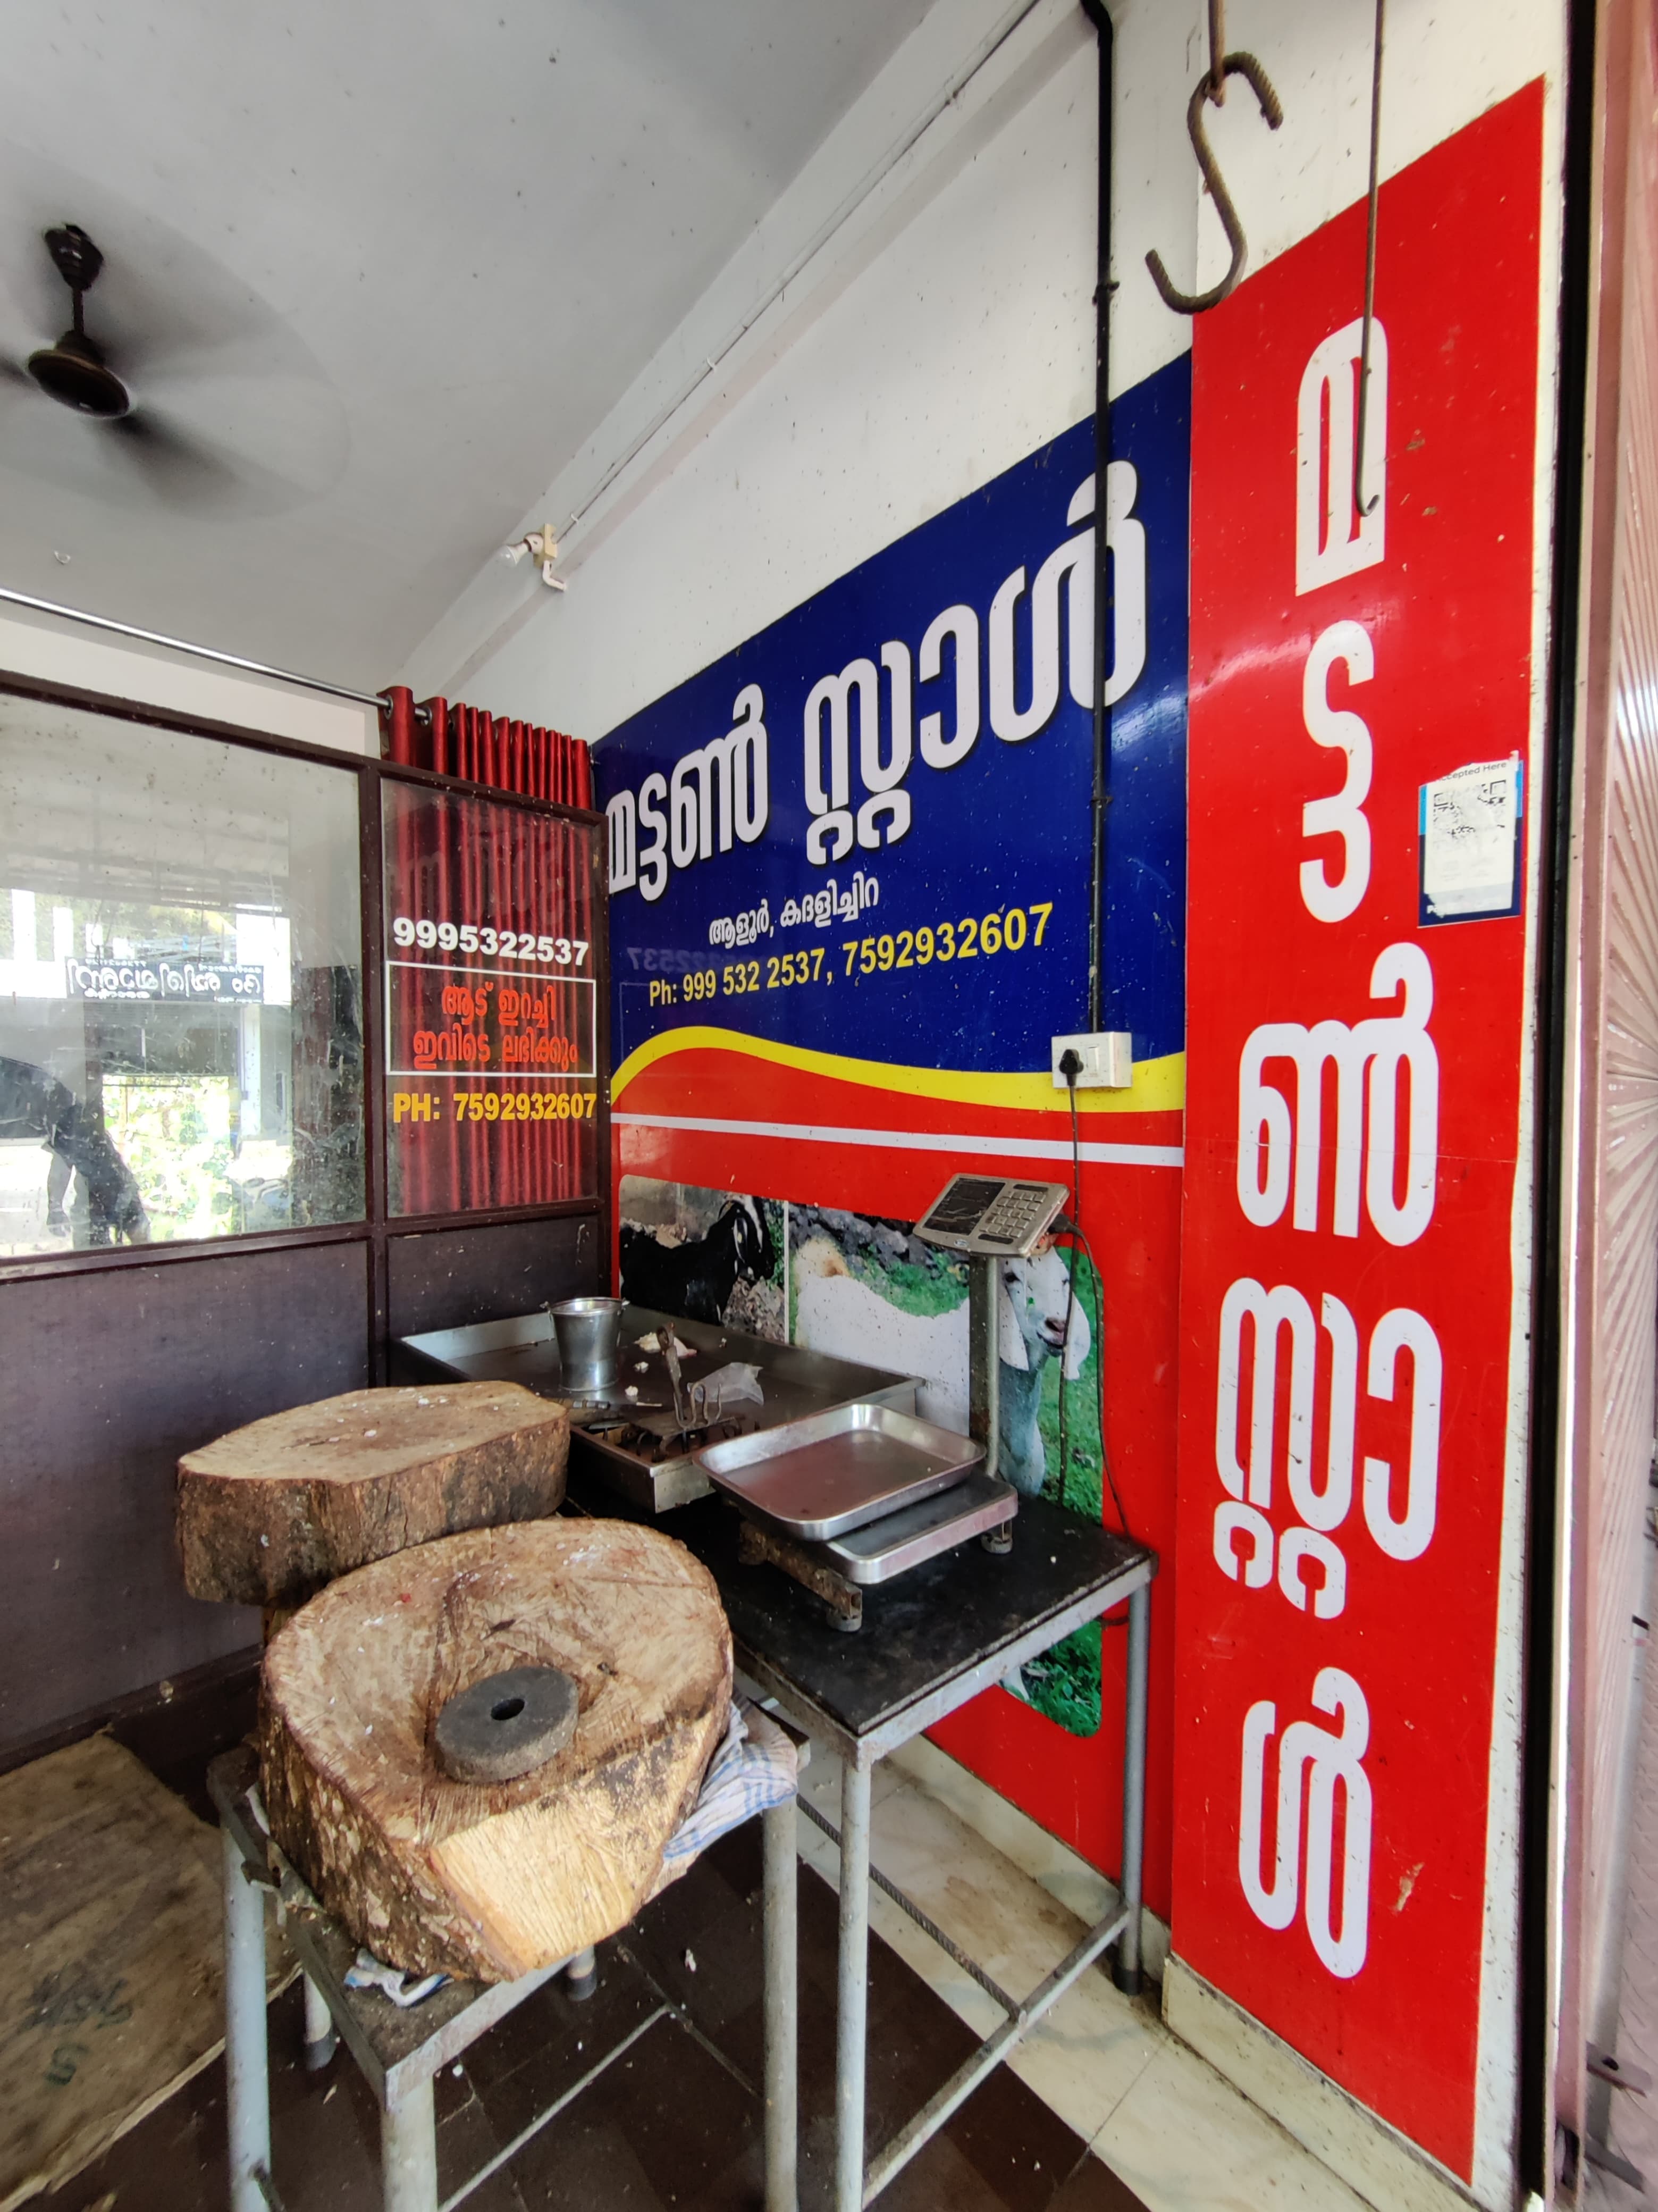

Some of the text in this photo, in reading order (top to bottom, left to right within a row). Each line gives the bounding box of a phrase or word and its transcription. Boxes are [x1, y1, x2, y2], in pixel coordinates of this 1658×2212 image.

[605, 683, 768, 901] മട്ടൺ
[1438, 761, 1507, 782] ccepted Here
[780, 871, 879, 928] കദളിച്ചിറ
[393, 917, 589, 966] 9995322537
[650, 979, 677, 1007] Ph:
[683, 969, 716, 1002] 999
[722, 961, 760, 995] 532
[842, 902, 1054, 977] 7592932607
[442, 981, 556, 1028] ആട് ഇറച്ചി
[413, 1023, 578, 1072] ഇവിടെ ലഭിക്കും
[393, 1092, 596, 1123] PH: 7592932607
